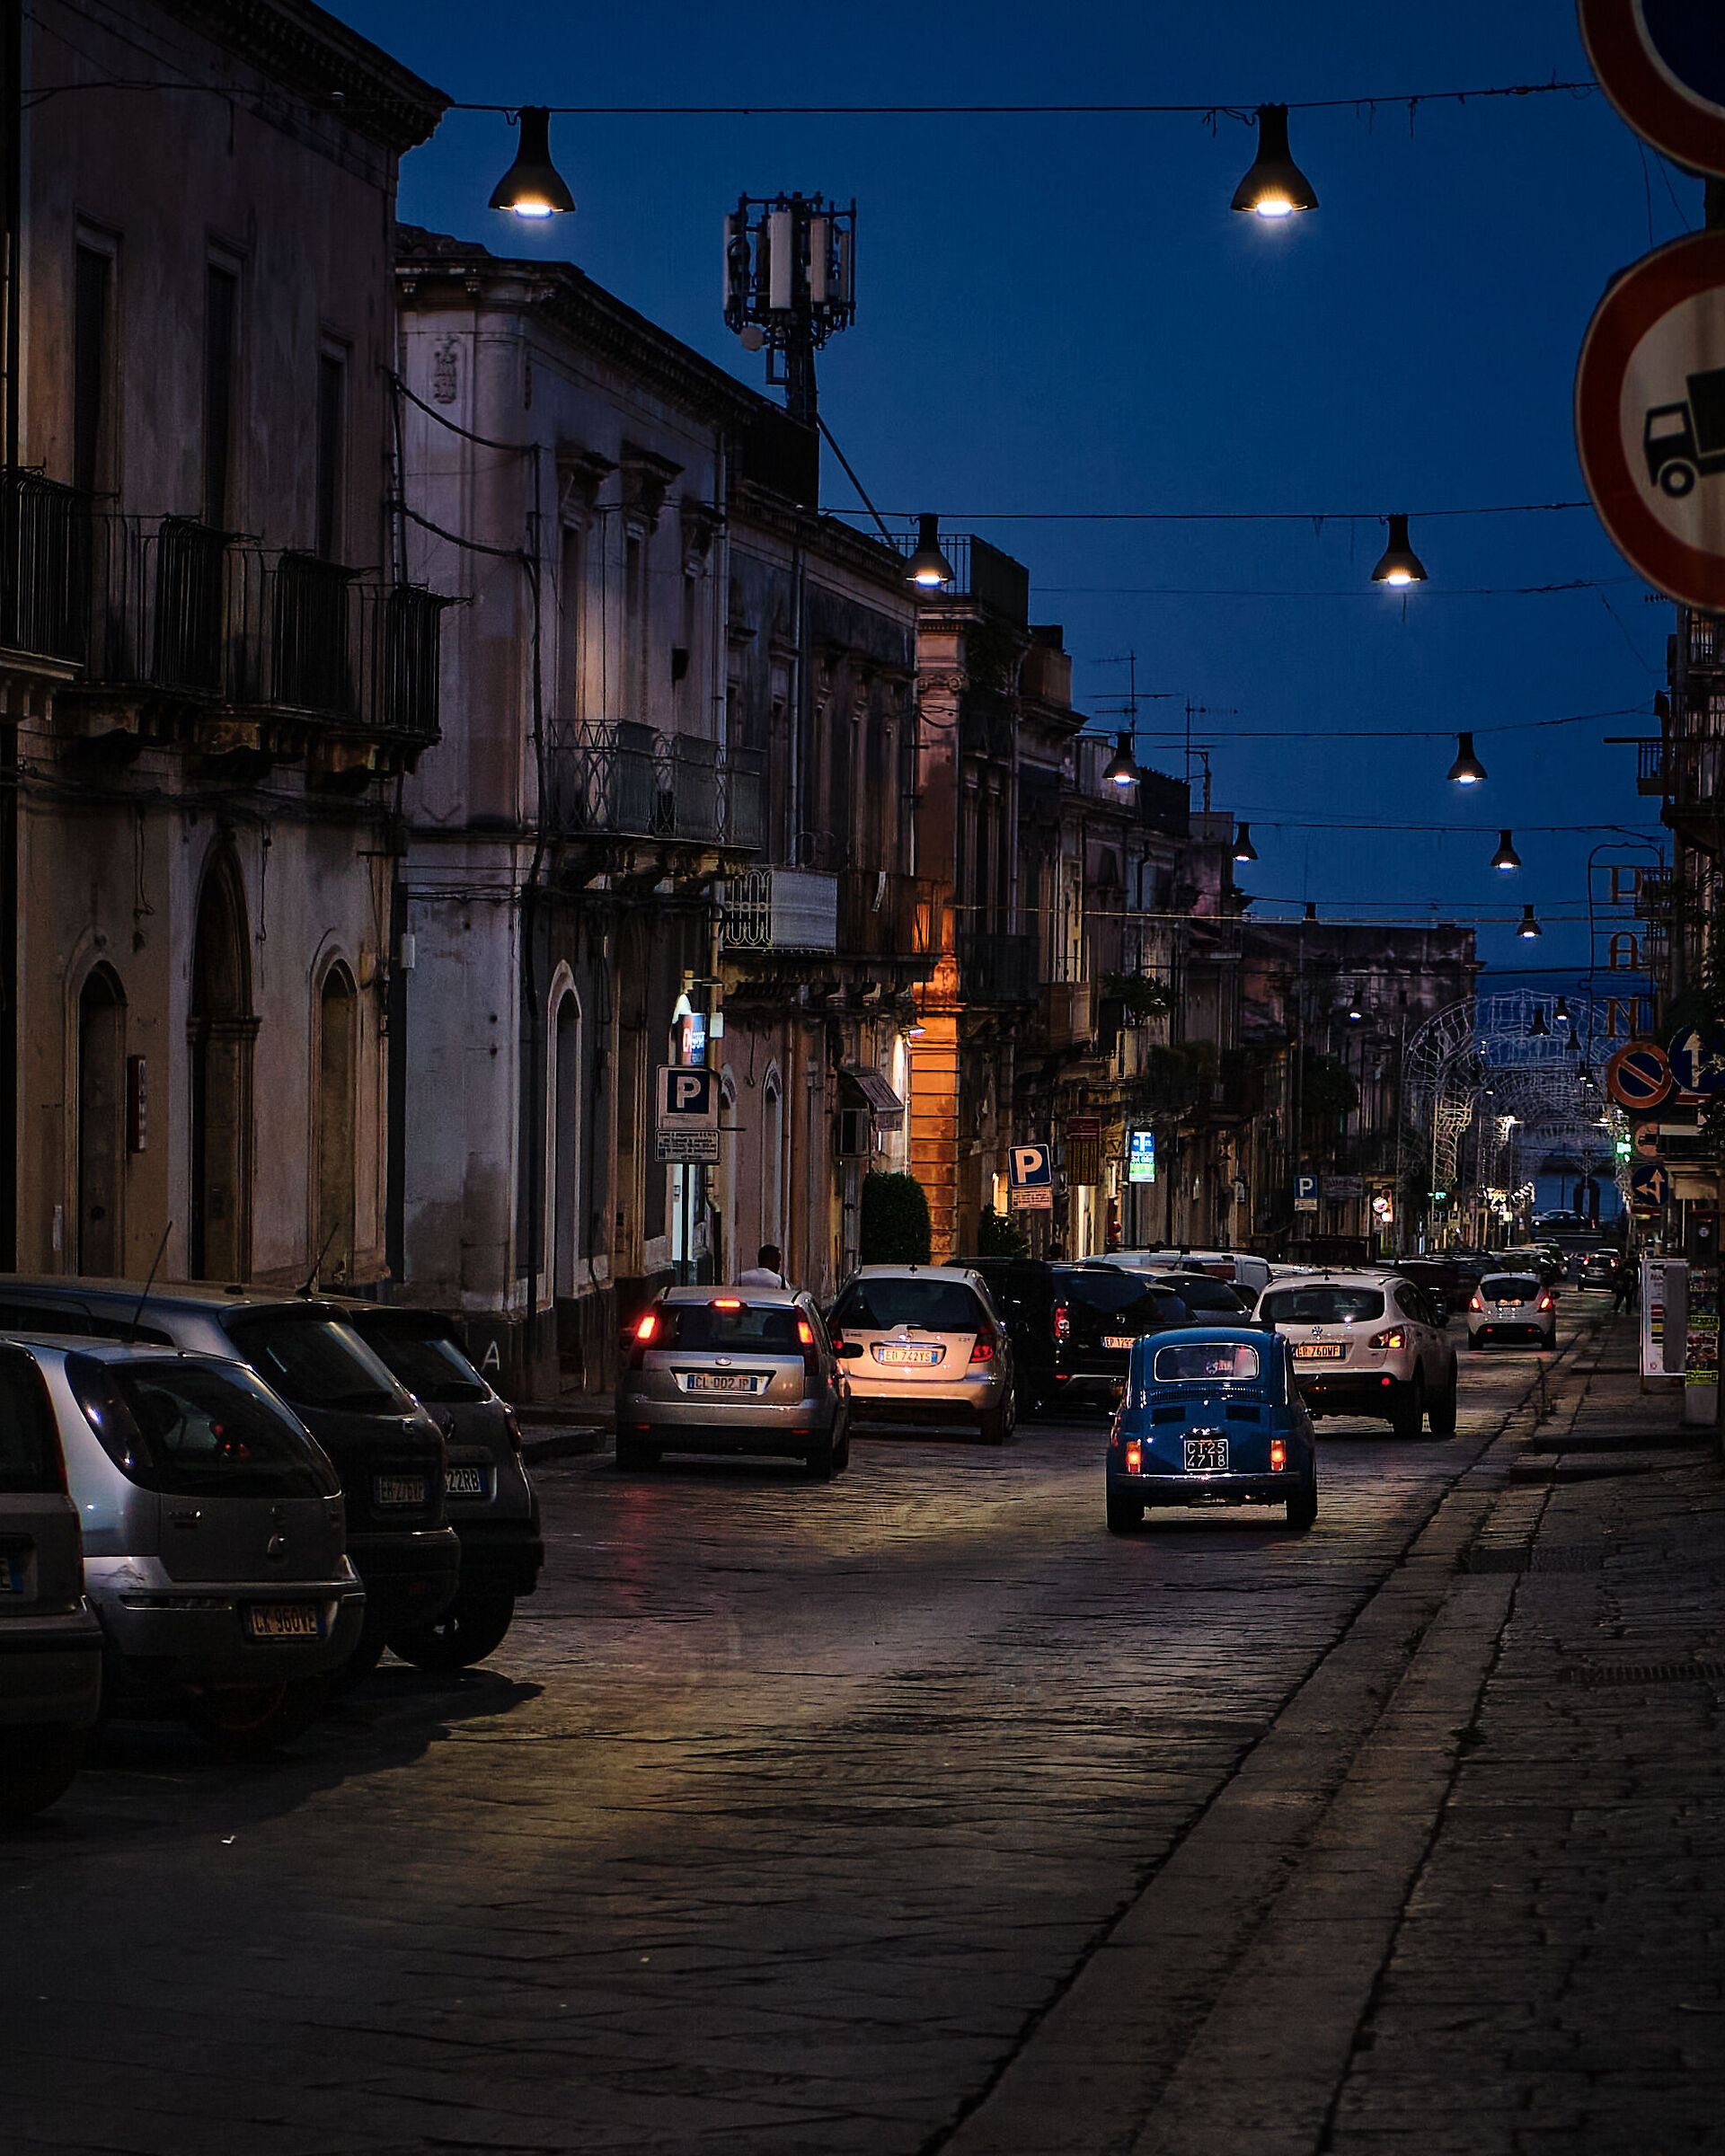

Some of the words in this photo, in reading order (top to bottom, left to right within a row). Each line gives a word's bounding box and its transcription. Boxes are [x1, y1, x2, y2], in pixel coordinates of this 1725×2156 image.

[677, 1075, 702, 1109] P
[1013, 1148, 1043, 1183] P
[1299, 1177, 1314, 1197] P
[481, 1339, 500, 1372] A
[1187, 1454, 1226, 1468] 4718
